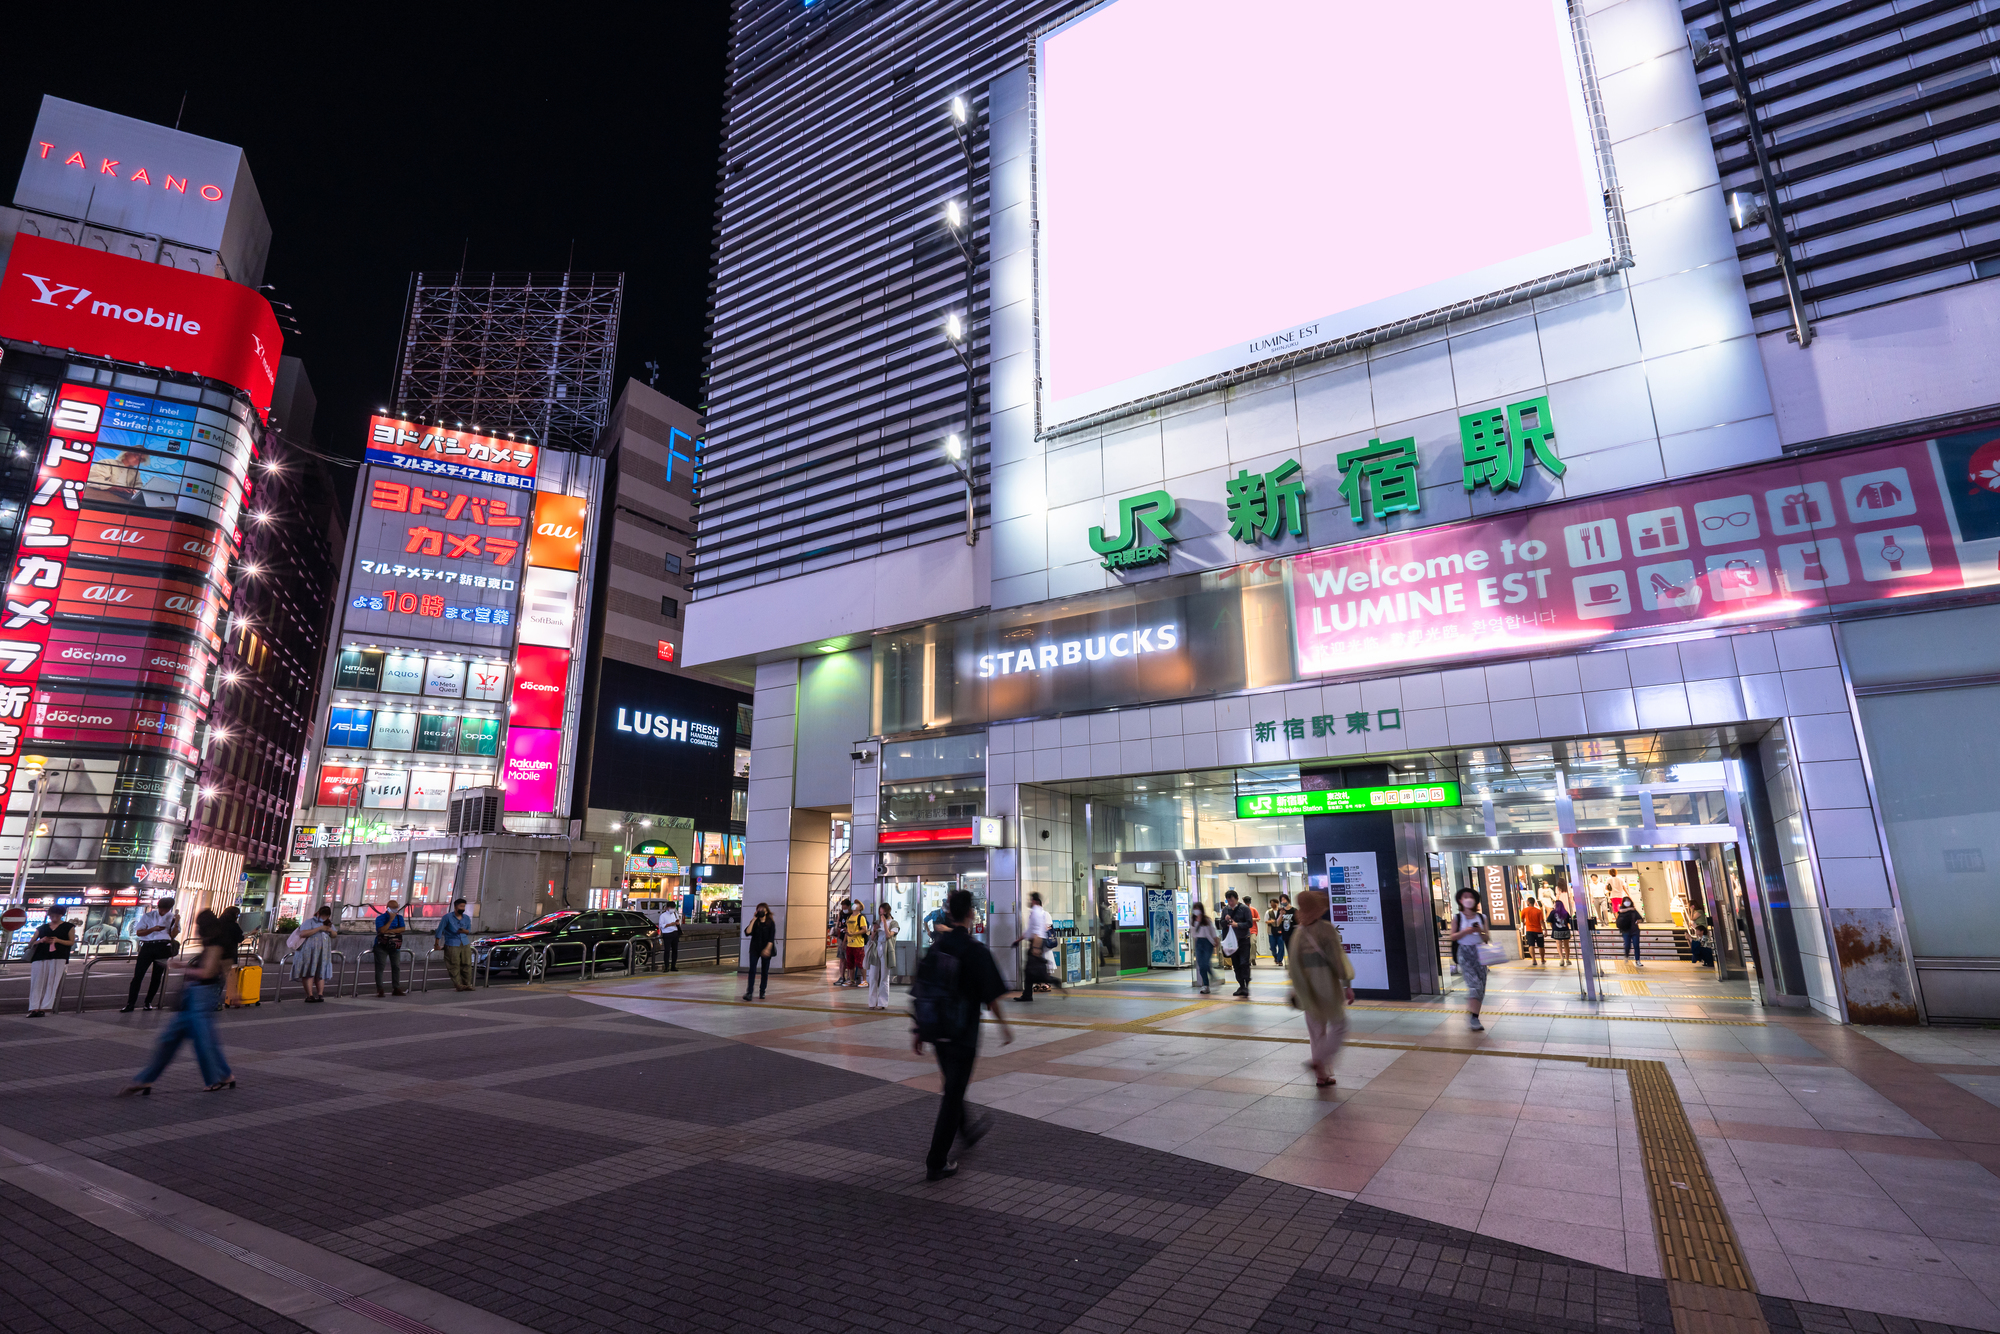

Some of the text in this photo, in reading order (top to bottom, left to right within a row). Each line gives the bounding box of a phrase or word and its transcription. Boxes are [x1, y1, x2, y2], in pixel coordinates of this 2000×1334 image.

[39, 142, 223, 201] TAKANO
[22, 273, 201, 335] Y! mobile
[1249, 323, 1320, 353] LUMINE EST
[159, 406, 180, 416] intel
[112, 418, 183, 437] Surface Pro 8
[373, 424, 534, 468] ヨドバシカメラ
[392, 454, 533, 489] マルチメディア新宿東口
[1088, 395, 1567, 555] JR 新宿駅
[371, 480, 522, 527] ヨドバシ
[99, 528, 145, 544] au
[536, 522, 579, 539] au
[182, 541, 215, 558] au
[404, 526, 520, 566] カメラ
[1100, 543, 1167, 569] JR東日本
[360, 559, 515, 592] マルチメディア新宿東口
[1306, 539, 1548, 599] Welcome to
[82, 585, 134, 603] au
[1312, 567, 1552, 635] LUMINE EST
[352, 589, 511, 626] よる10時まで営業
[530, 615, 565, 627] SoftBank
[1471, 608, 1557, 636] 환영합니다
[61, 648, 127, 663] docomo
[978, 625, 1178, 679] STARBUCKS
[345, 665, 376, 673] HITACHI
[387, 670, 419, 679] AQUOS
[475, 672, 500, 687] Y!
[520, 681, 560, 693] docomo
[46, 710, 113, 725] docomo
[617, 707, 688, 742] LUSH
[1255, 708, 1401, 743] 新宿駅東口
[332, 722, 369, 732] ASUS
[379, 727, 410, 735] BRAVIA
[690, 722, 720, 736] FRESH
[465, 733, 494, 741] oppo
[690, 731, 719, 742] HANDMADE
[690, 738, 719, 748] COSMETICS
[509, 758, 553, 771] Rakuten
[324, 776, 359, 784] BUFFALO
[508, 770, 541, 782] Mobile
[1249, 794, 1308, 811] JR 新宿駅
[1326, 791, 1351, 801] 東改札
[1373, 794, 1382, 802] JY
[1276, 807, 1302, 815] Shinjuku
[642, 846, 669, 855] SUBWAY
[631, 881, 662, 890] SUBWAY
